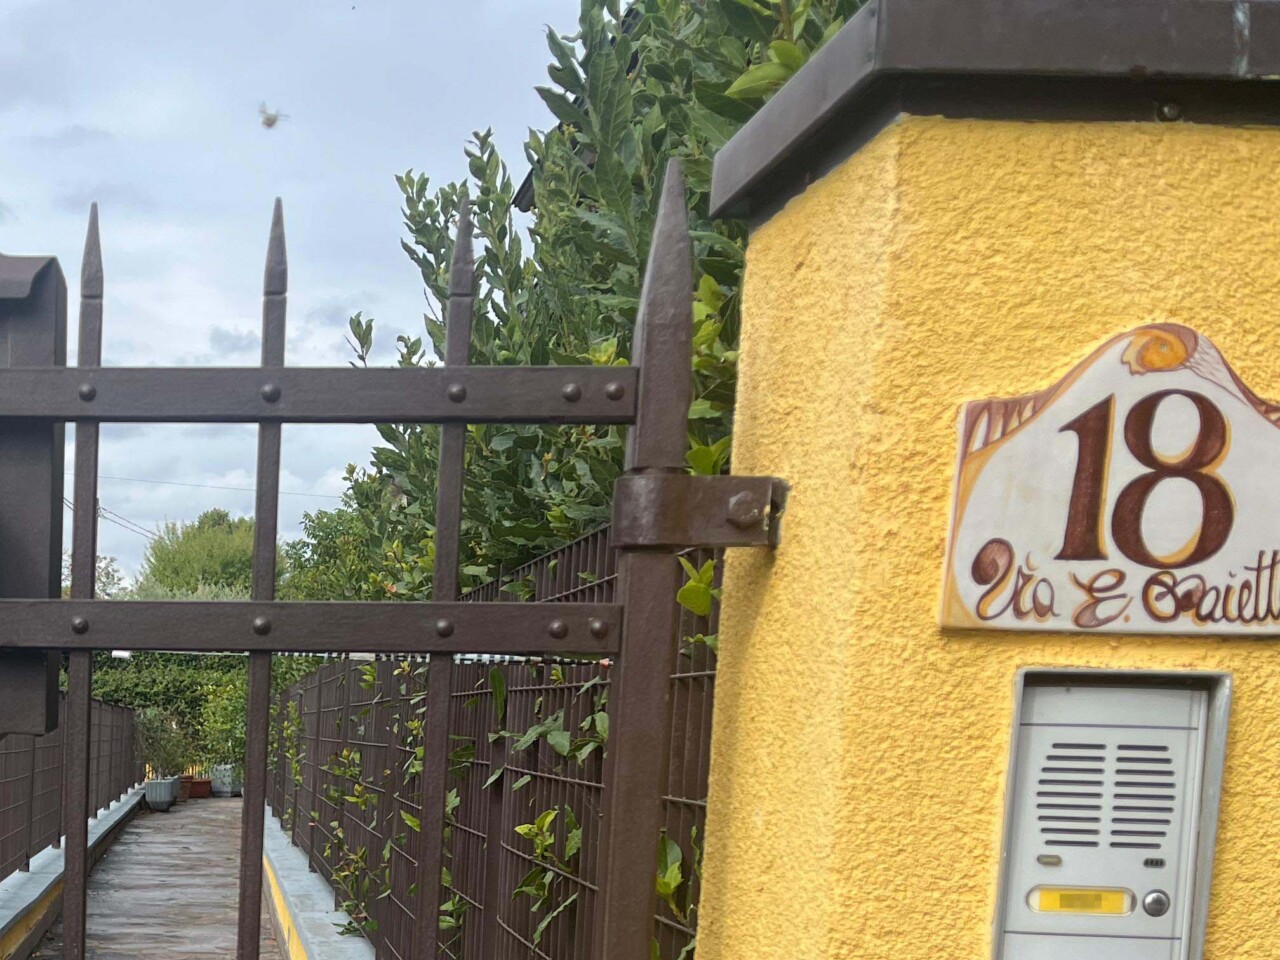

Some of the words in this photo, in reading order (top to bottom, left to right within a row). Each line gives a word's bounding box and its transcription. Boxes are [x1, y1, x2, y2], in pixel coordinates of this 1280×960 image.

[1054, 388, 1236, 570] 18
[971, 538, 1061, 622] Via
[1072, 568, 1134, 628] E.
